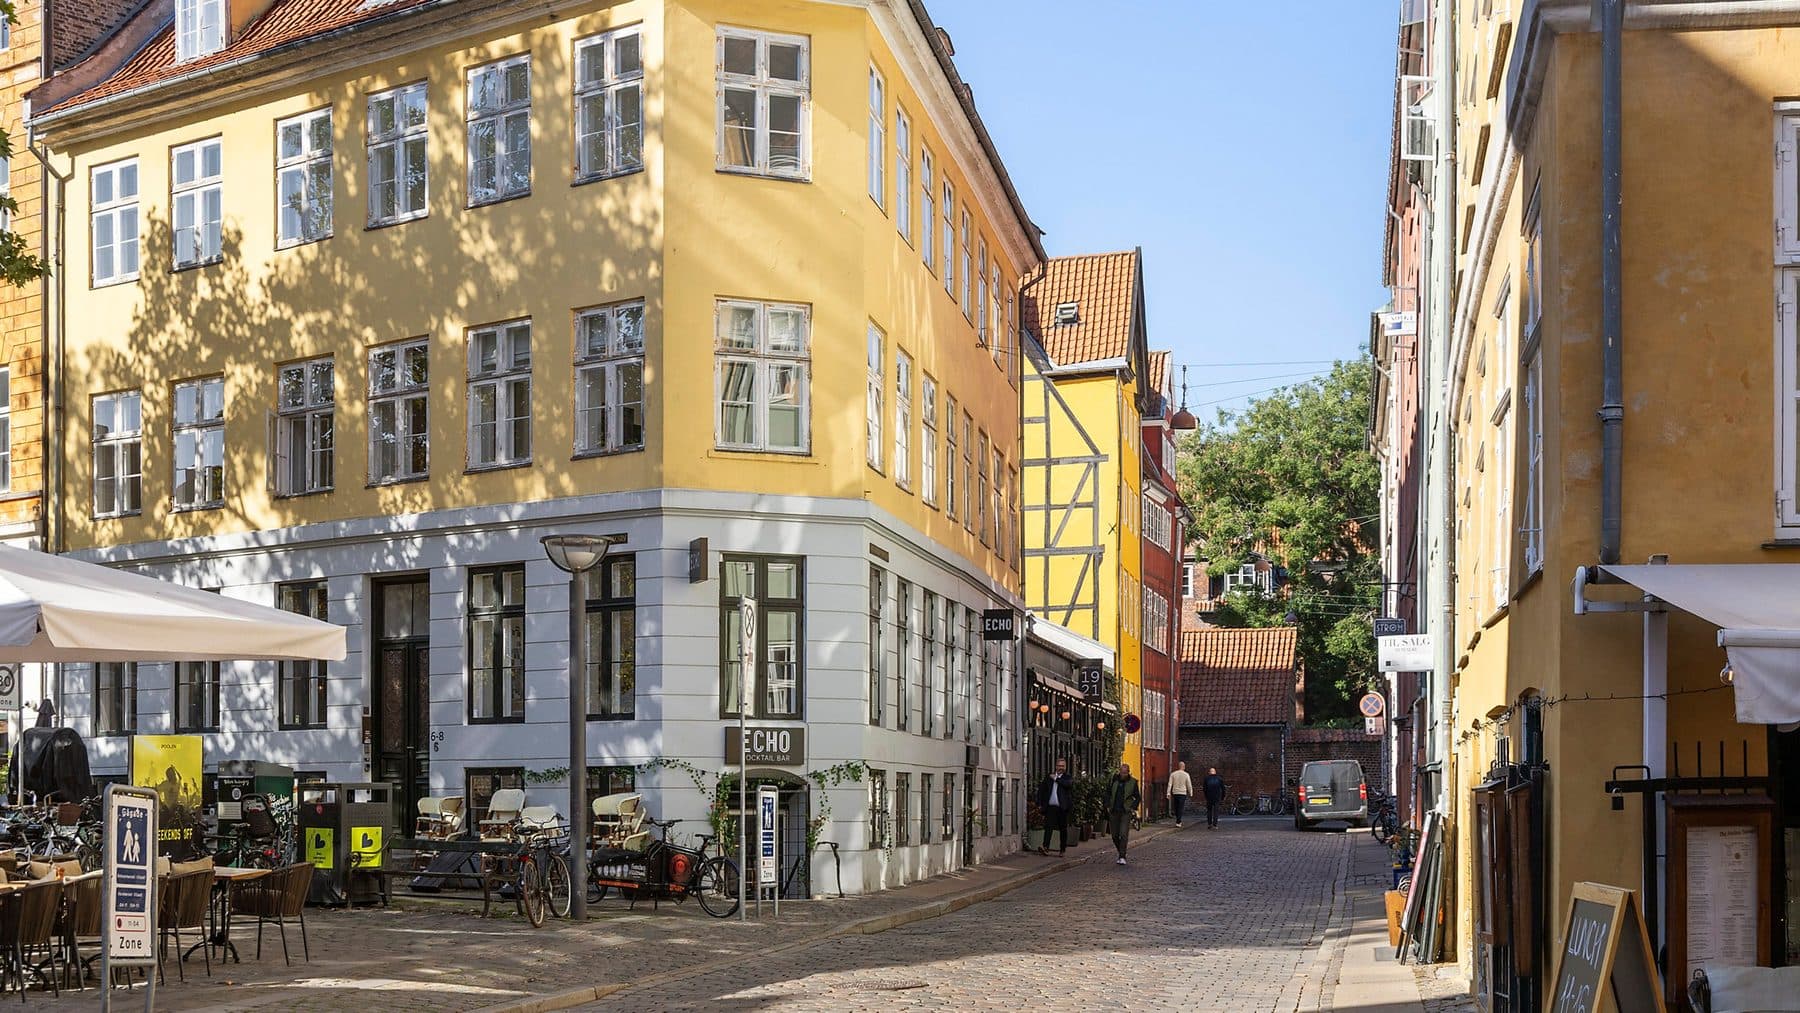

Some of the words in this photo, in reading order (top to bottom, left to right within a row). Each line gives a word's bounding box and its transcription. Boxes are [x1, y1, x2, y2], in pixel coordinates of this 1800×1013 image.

[985, 618, 1012, 631] ECHO
[1081, 670, 1100, 683] 19
[1081, 684, 1100, 697] 21
[431, 731, 444, 741] 6-8
[433, 742, 439, 752] 6
[745, 754, 775, 762] OCKTAIL
[776, 754, 791, 762] BAR
[183, 828, 193, 840] OFF
[119, 936, 143, 950] Zone
[1567, 916, 1607, 970] LUNCH
